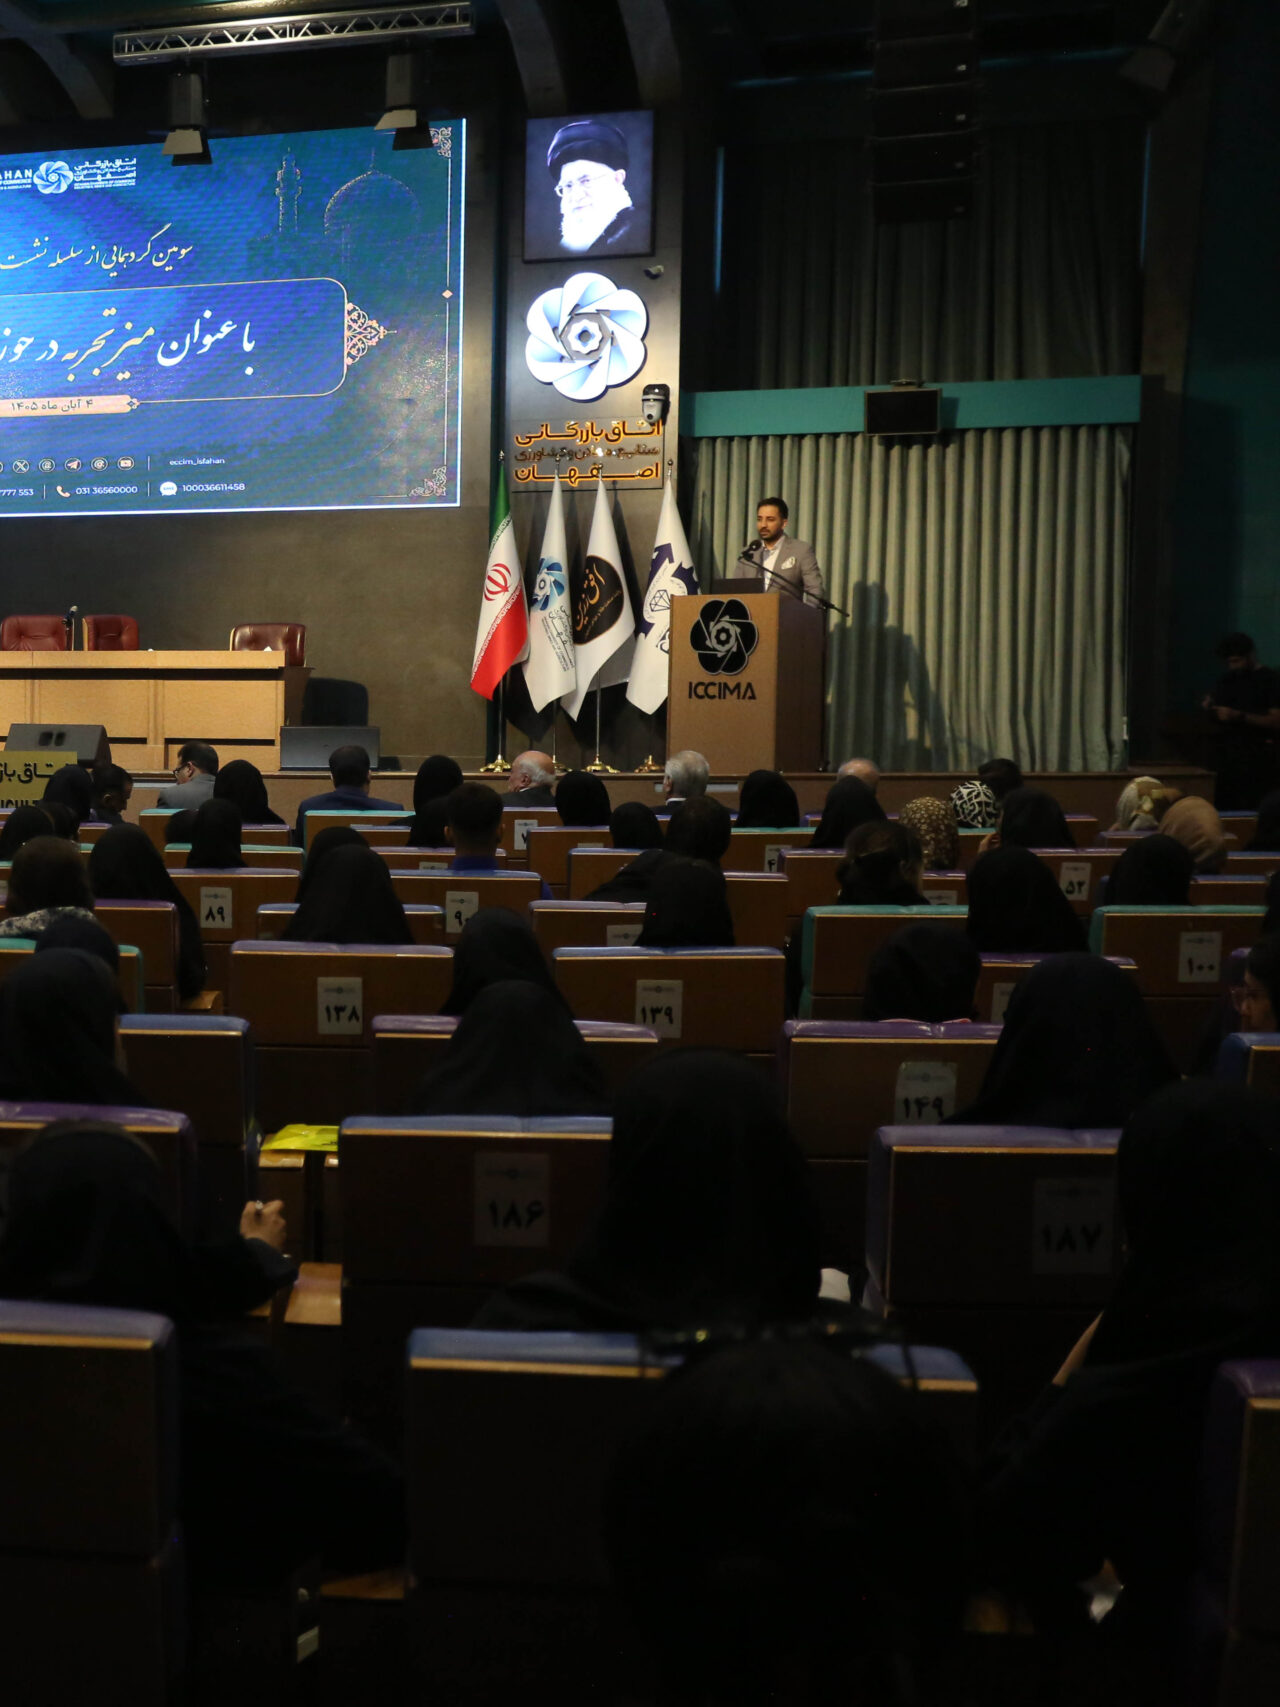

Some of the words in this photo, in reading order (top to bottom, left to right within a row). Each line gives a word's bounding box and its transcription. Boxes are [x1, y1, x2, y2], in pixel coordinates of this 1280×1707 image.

[48, 246, 84, 268] سلسله
[85, 245, 100, 265] از
[151, 244, 193, 271] سومین
[60, 306, 118, 382] تجربه
[156, 308, 237, 368] عنوان
[36, 339, 60, 362] در
[102, 320, 156, 381] میز
[241, 322, 256, 377] با
[11, 401, 39, 411] ۱۴۰۵
[41, 400, 58, 410] ماه
[61, 399, 81, 412] آبان
[86, 399, 93, 408] ۴
[514, 419, 605, 446] بازرگانی
[604, 418, 662, 445] اتاق
[170, 457, 225, 466] eccim_isfahan
[513, 461, 661, 487] اصفهان
[18, 487, 34, 496] 553
[75, 487, 90, 495] 031
[92, 485, 138, 495] 36560000
[688, 681, 756, 700] ICCIMA
[17, 761, 67, 783] تاق
[1065, 880, 1085, 894] ۵۲
[205, 906, 225, 921] ۸۹
[1188, 957, 1215, 975] ۱۰۰
[325, 1005, 360, 1022] ۱۳۸
[641, 1006, 674, 1024] ۱۳۹
[902, 1097, 944, 1119] ۱۴۹
[489, 1199, 544, 1229] ۱۸۶
[1042, 1223, 1102, 1253] ۱۸۷
